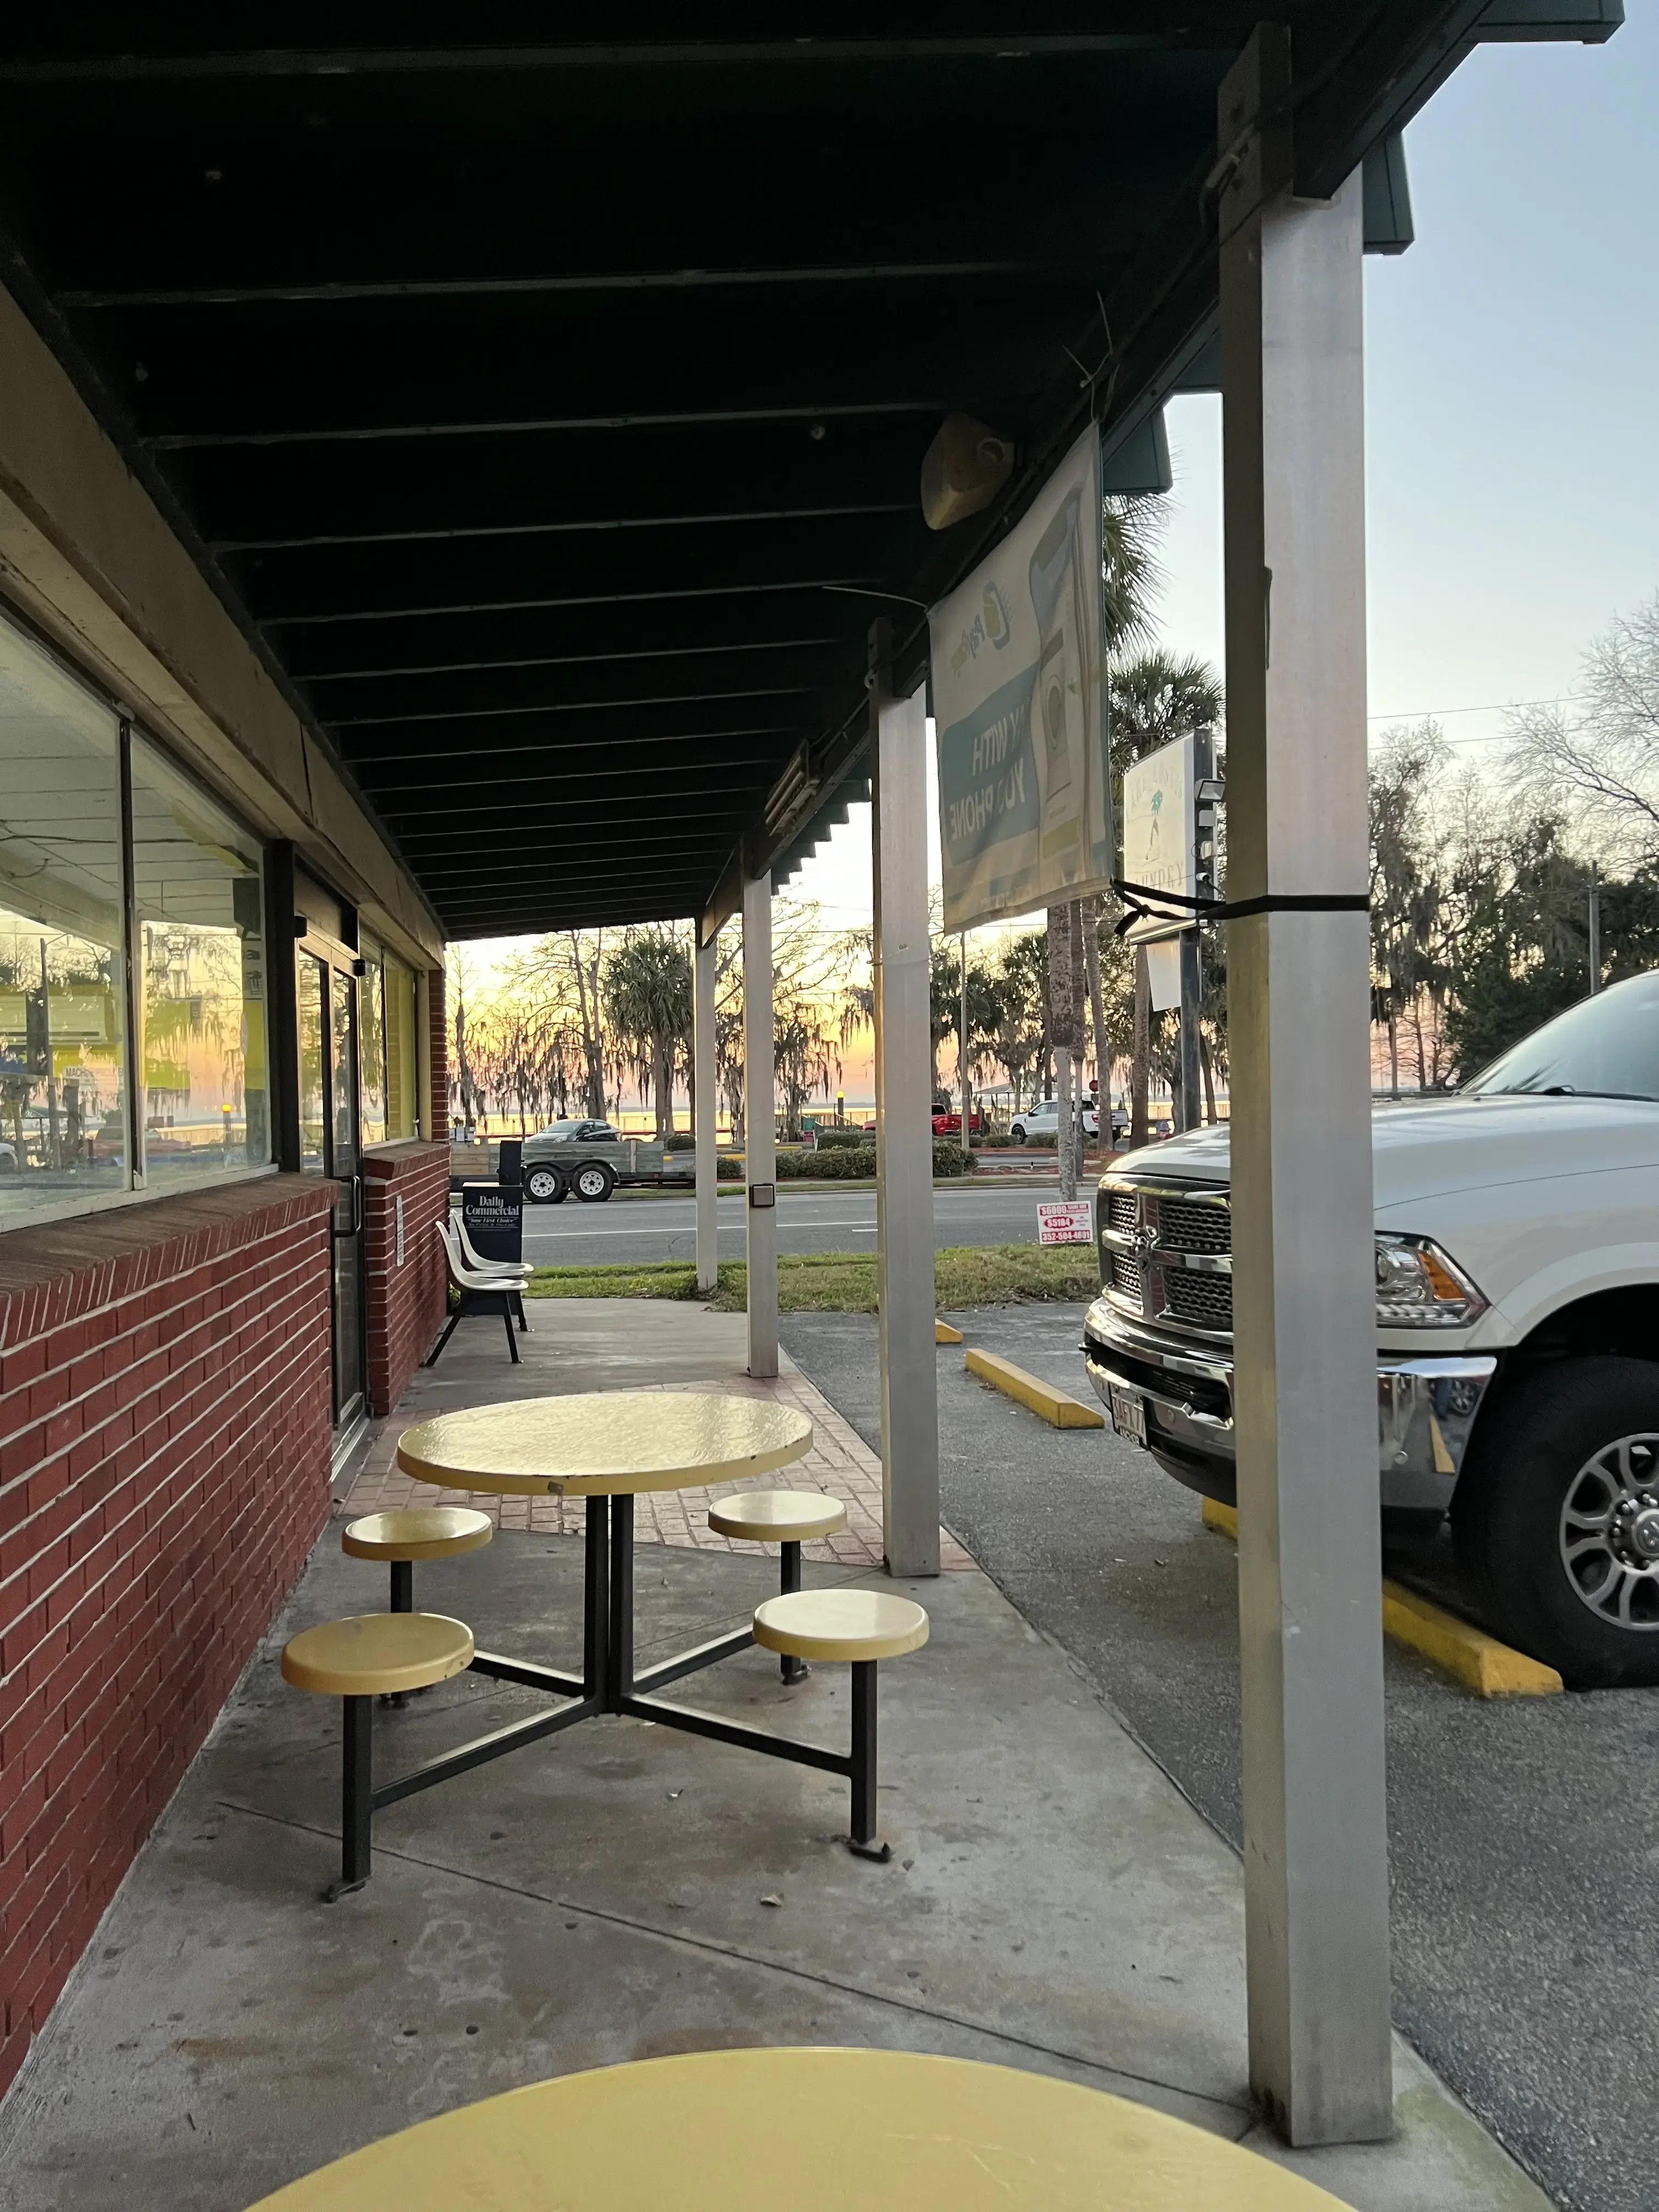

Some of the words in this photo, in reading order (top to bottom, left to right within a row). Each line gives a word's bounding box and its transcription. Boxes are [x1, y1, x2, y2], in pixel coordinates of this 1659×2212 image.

[1135, 860, 1183, 890] UNDRY
[479, 1195, 504, 1208] Daily
[465, 1204, 519, 1216] Commercial
[1042, 1205, 1066, 1215] $6000
